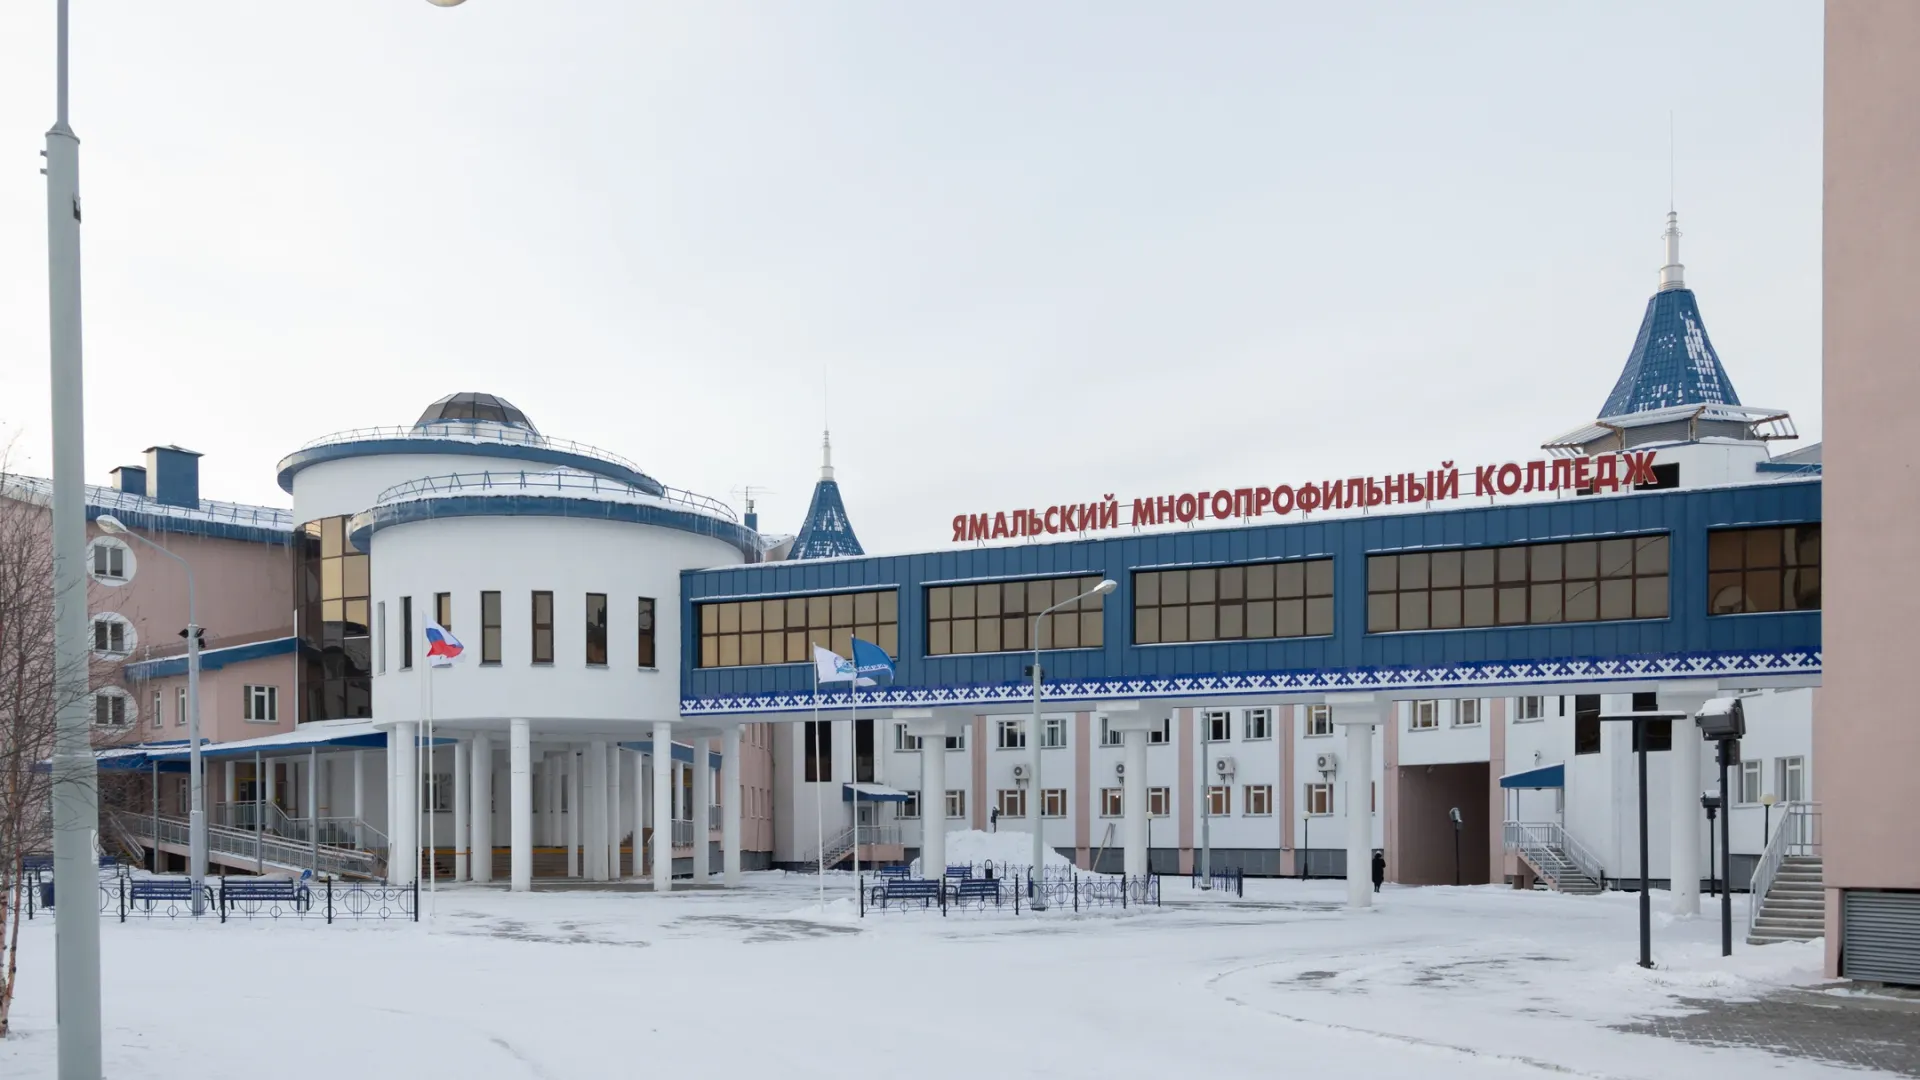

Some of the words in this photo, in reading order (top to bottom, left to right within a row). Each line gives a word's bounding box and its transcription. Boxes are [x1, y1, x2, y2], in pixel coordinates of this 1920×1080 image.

[952, 493, 1119, 542] ЯМАЛЬСКИЙ
[1131, 460, 1460, 527] МНОГОПРОФИЛЬНЫЙ
[1475, 451, 1658, 496] КОЛЛЕДЖ
